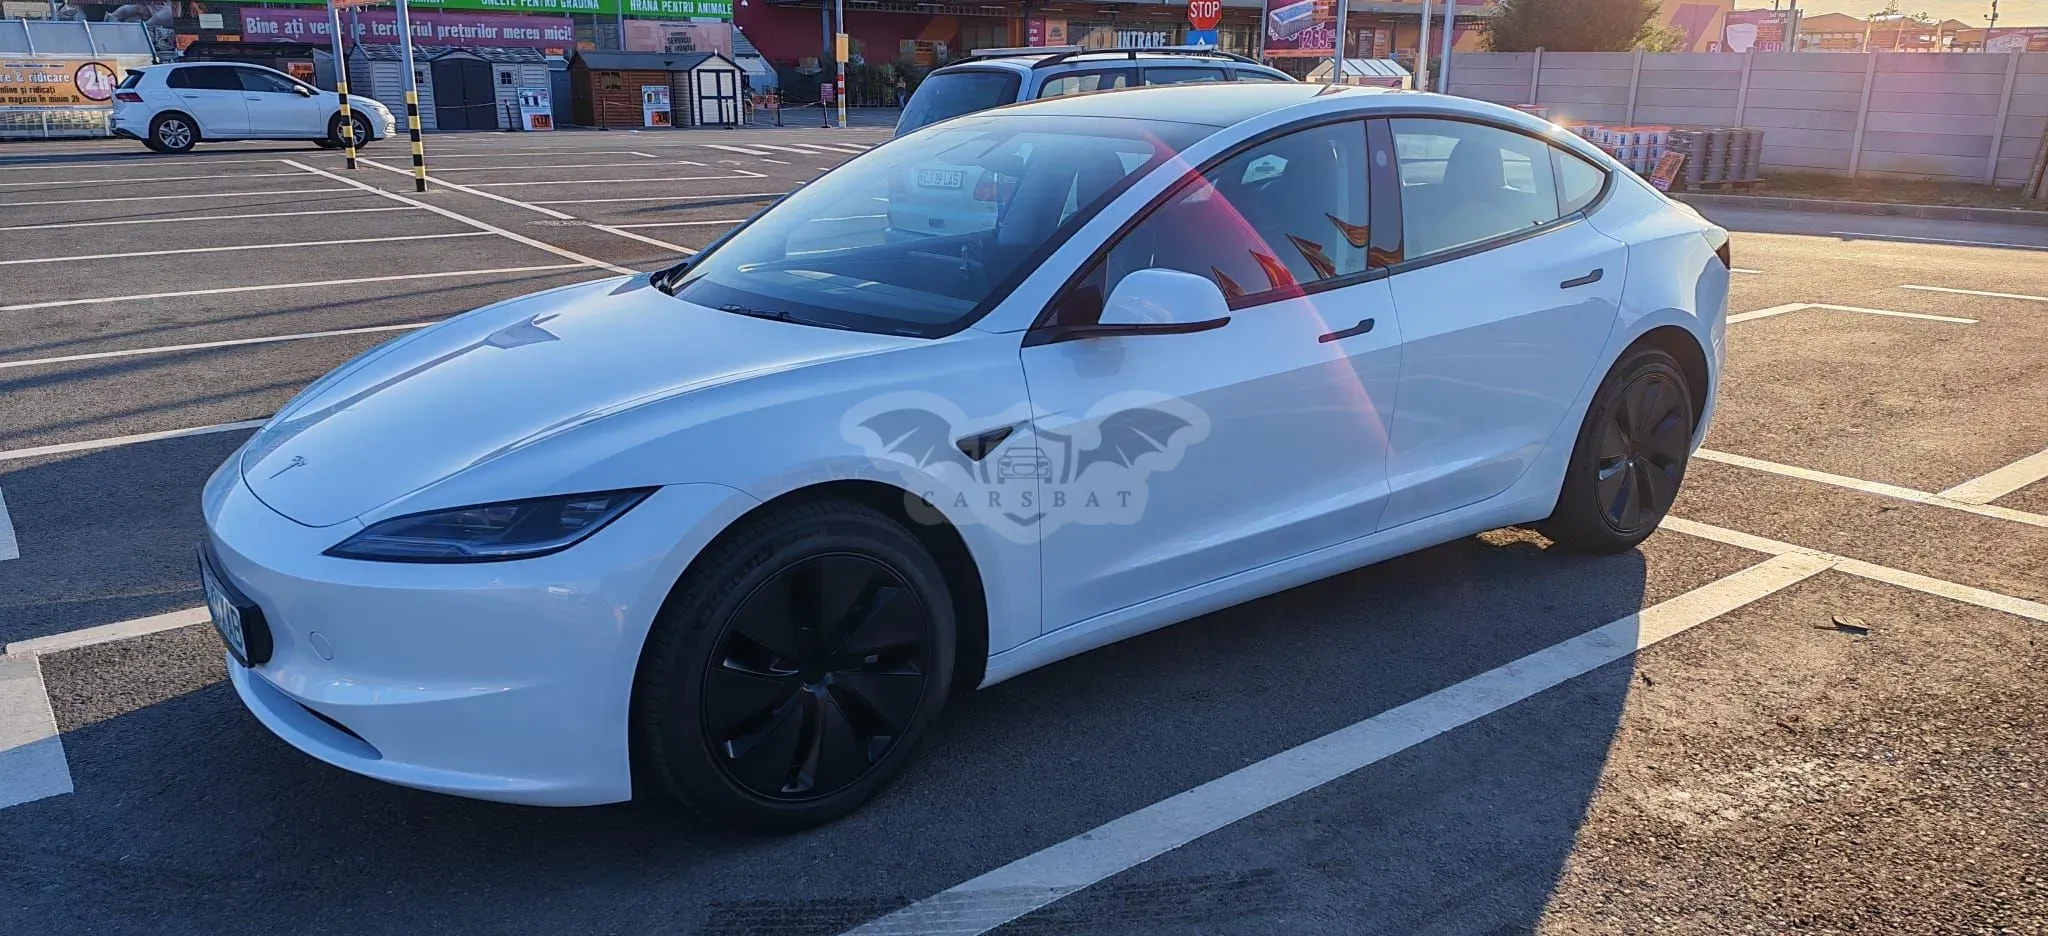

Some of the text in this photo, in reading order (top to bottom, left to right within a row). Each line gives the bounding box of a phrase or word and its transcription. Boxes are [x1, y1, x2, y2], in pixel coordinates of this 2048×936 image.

[662, 1, 694, 13] PENTRU
[698, 3, 732, 15] ANIMALE
[1190, 1, 1220, 18] STOP
[246, 17, 278, 34] Bine
[285, 18, 303, 39] ați
[309, 21, 344, 35] vent
[372, 20, 432, 37] teririul
[437, 23, 498, 42] prețurilor
[503, 27, 540, 40] mereu
[545, 26, 572, 41] mici!
[1117, 31, 1166, 49] INTRARE
[16, 71, 24, 82] &
[29, 70, 70, 82] ridicare
[85, 71, 108, 91] 2h
